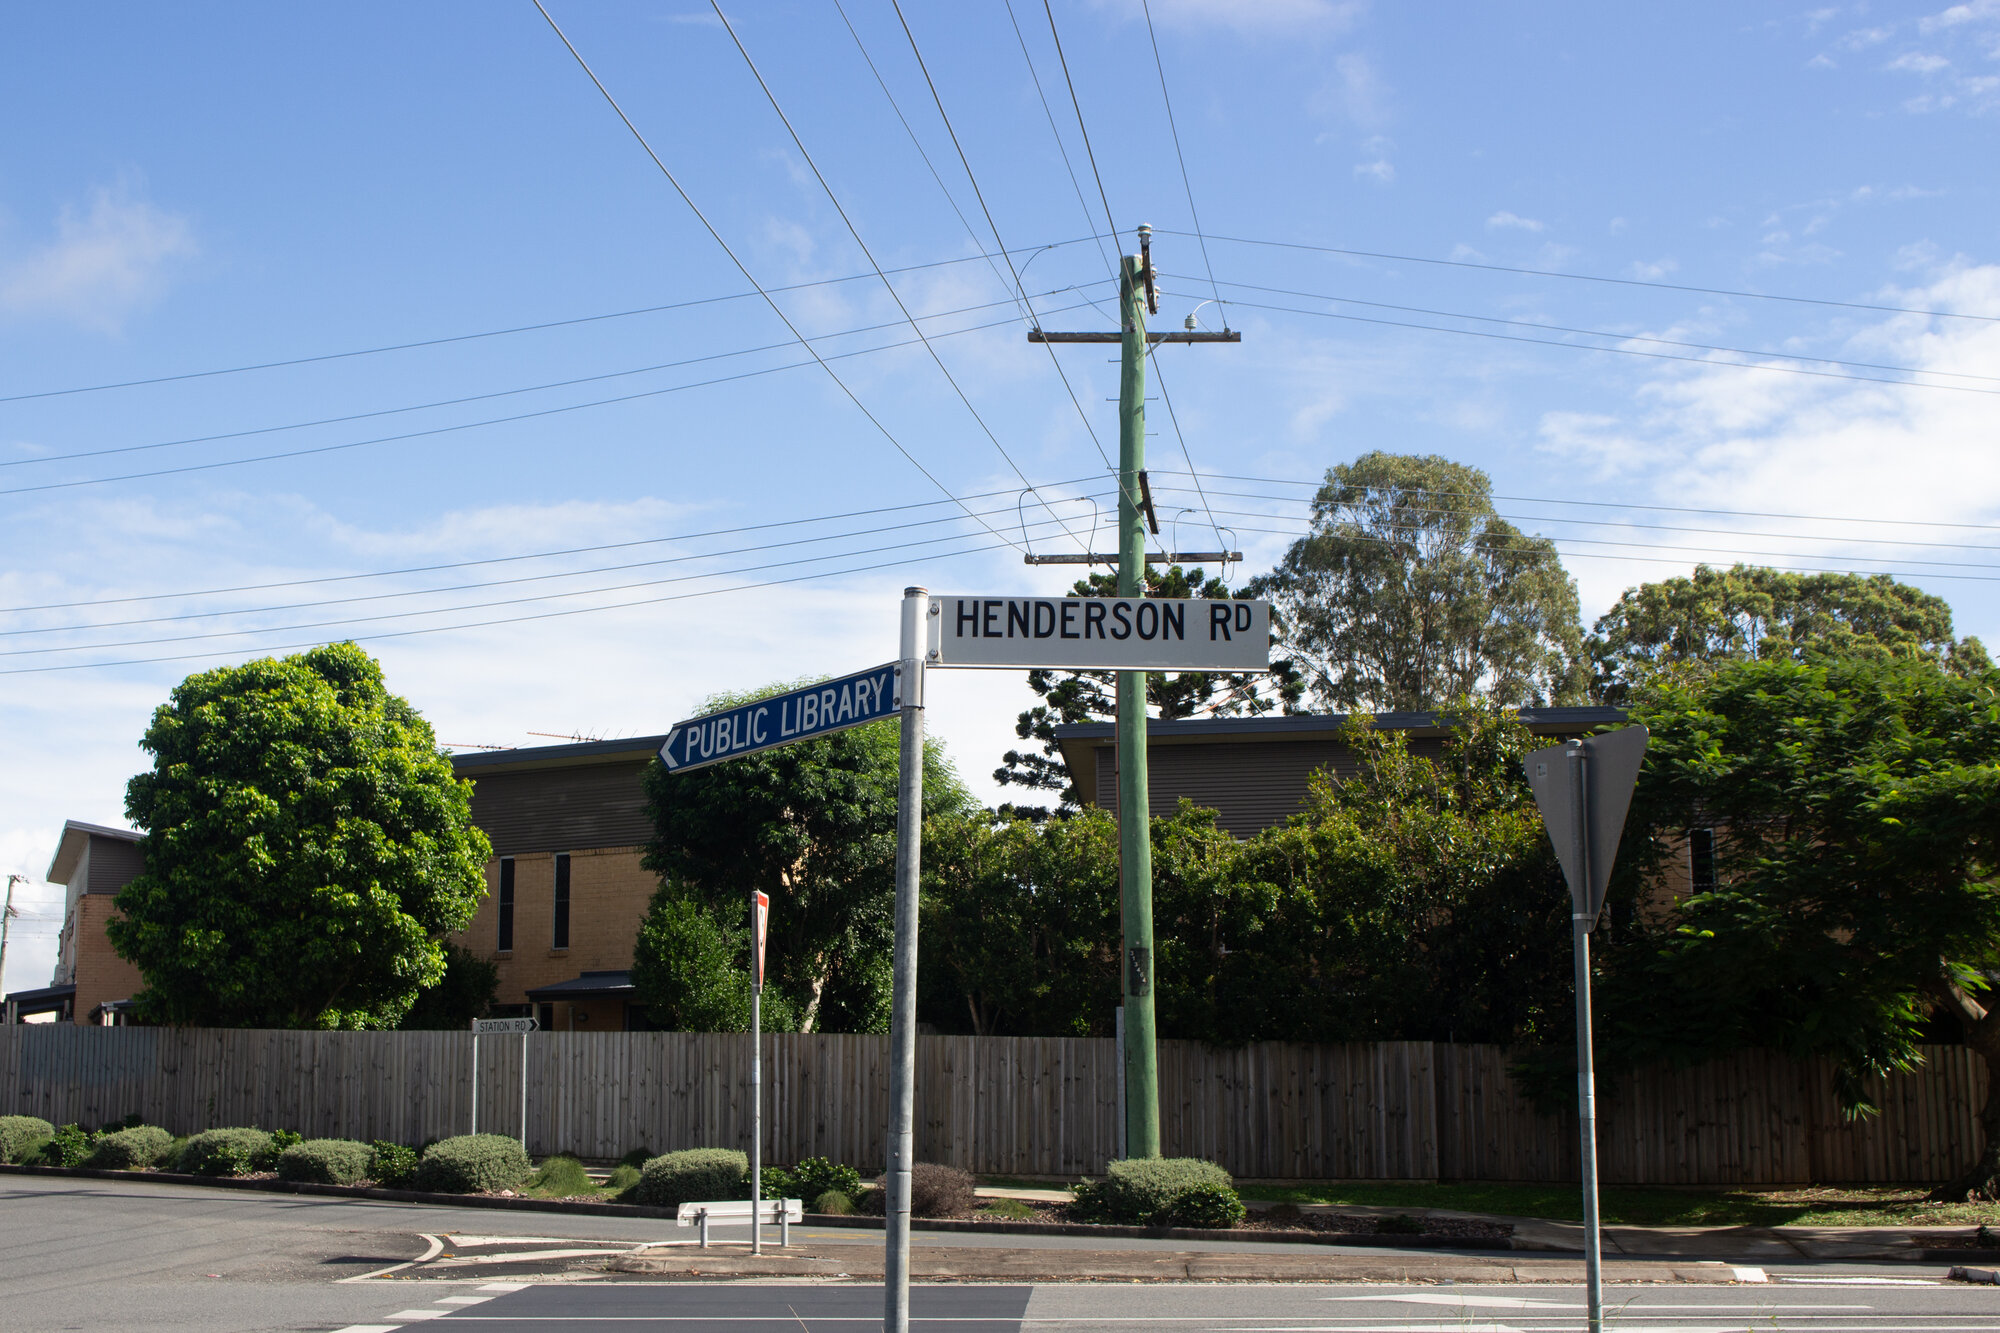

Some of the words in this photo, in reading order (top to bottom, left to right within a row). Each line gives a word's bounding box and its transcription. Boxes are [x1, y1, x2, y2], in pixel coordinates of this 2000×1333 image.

[956, 600, 1184, 641] HENDERSON
[1210, 603, 1252, 641] RD
[685, 707, 768, 762] PUBLIC
[781, 673, 887, 737] LIBRARY
[479, 1021, 510, 1032] STATION
[515, 1020, 526, 1031] RD
